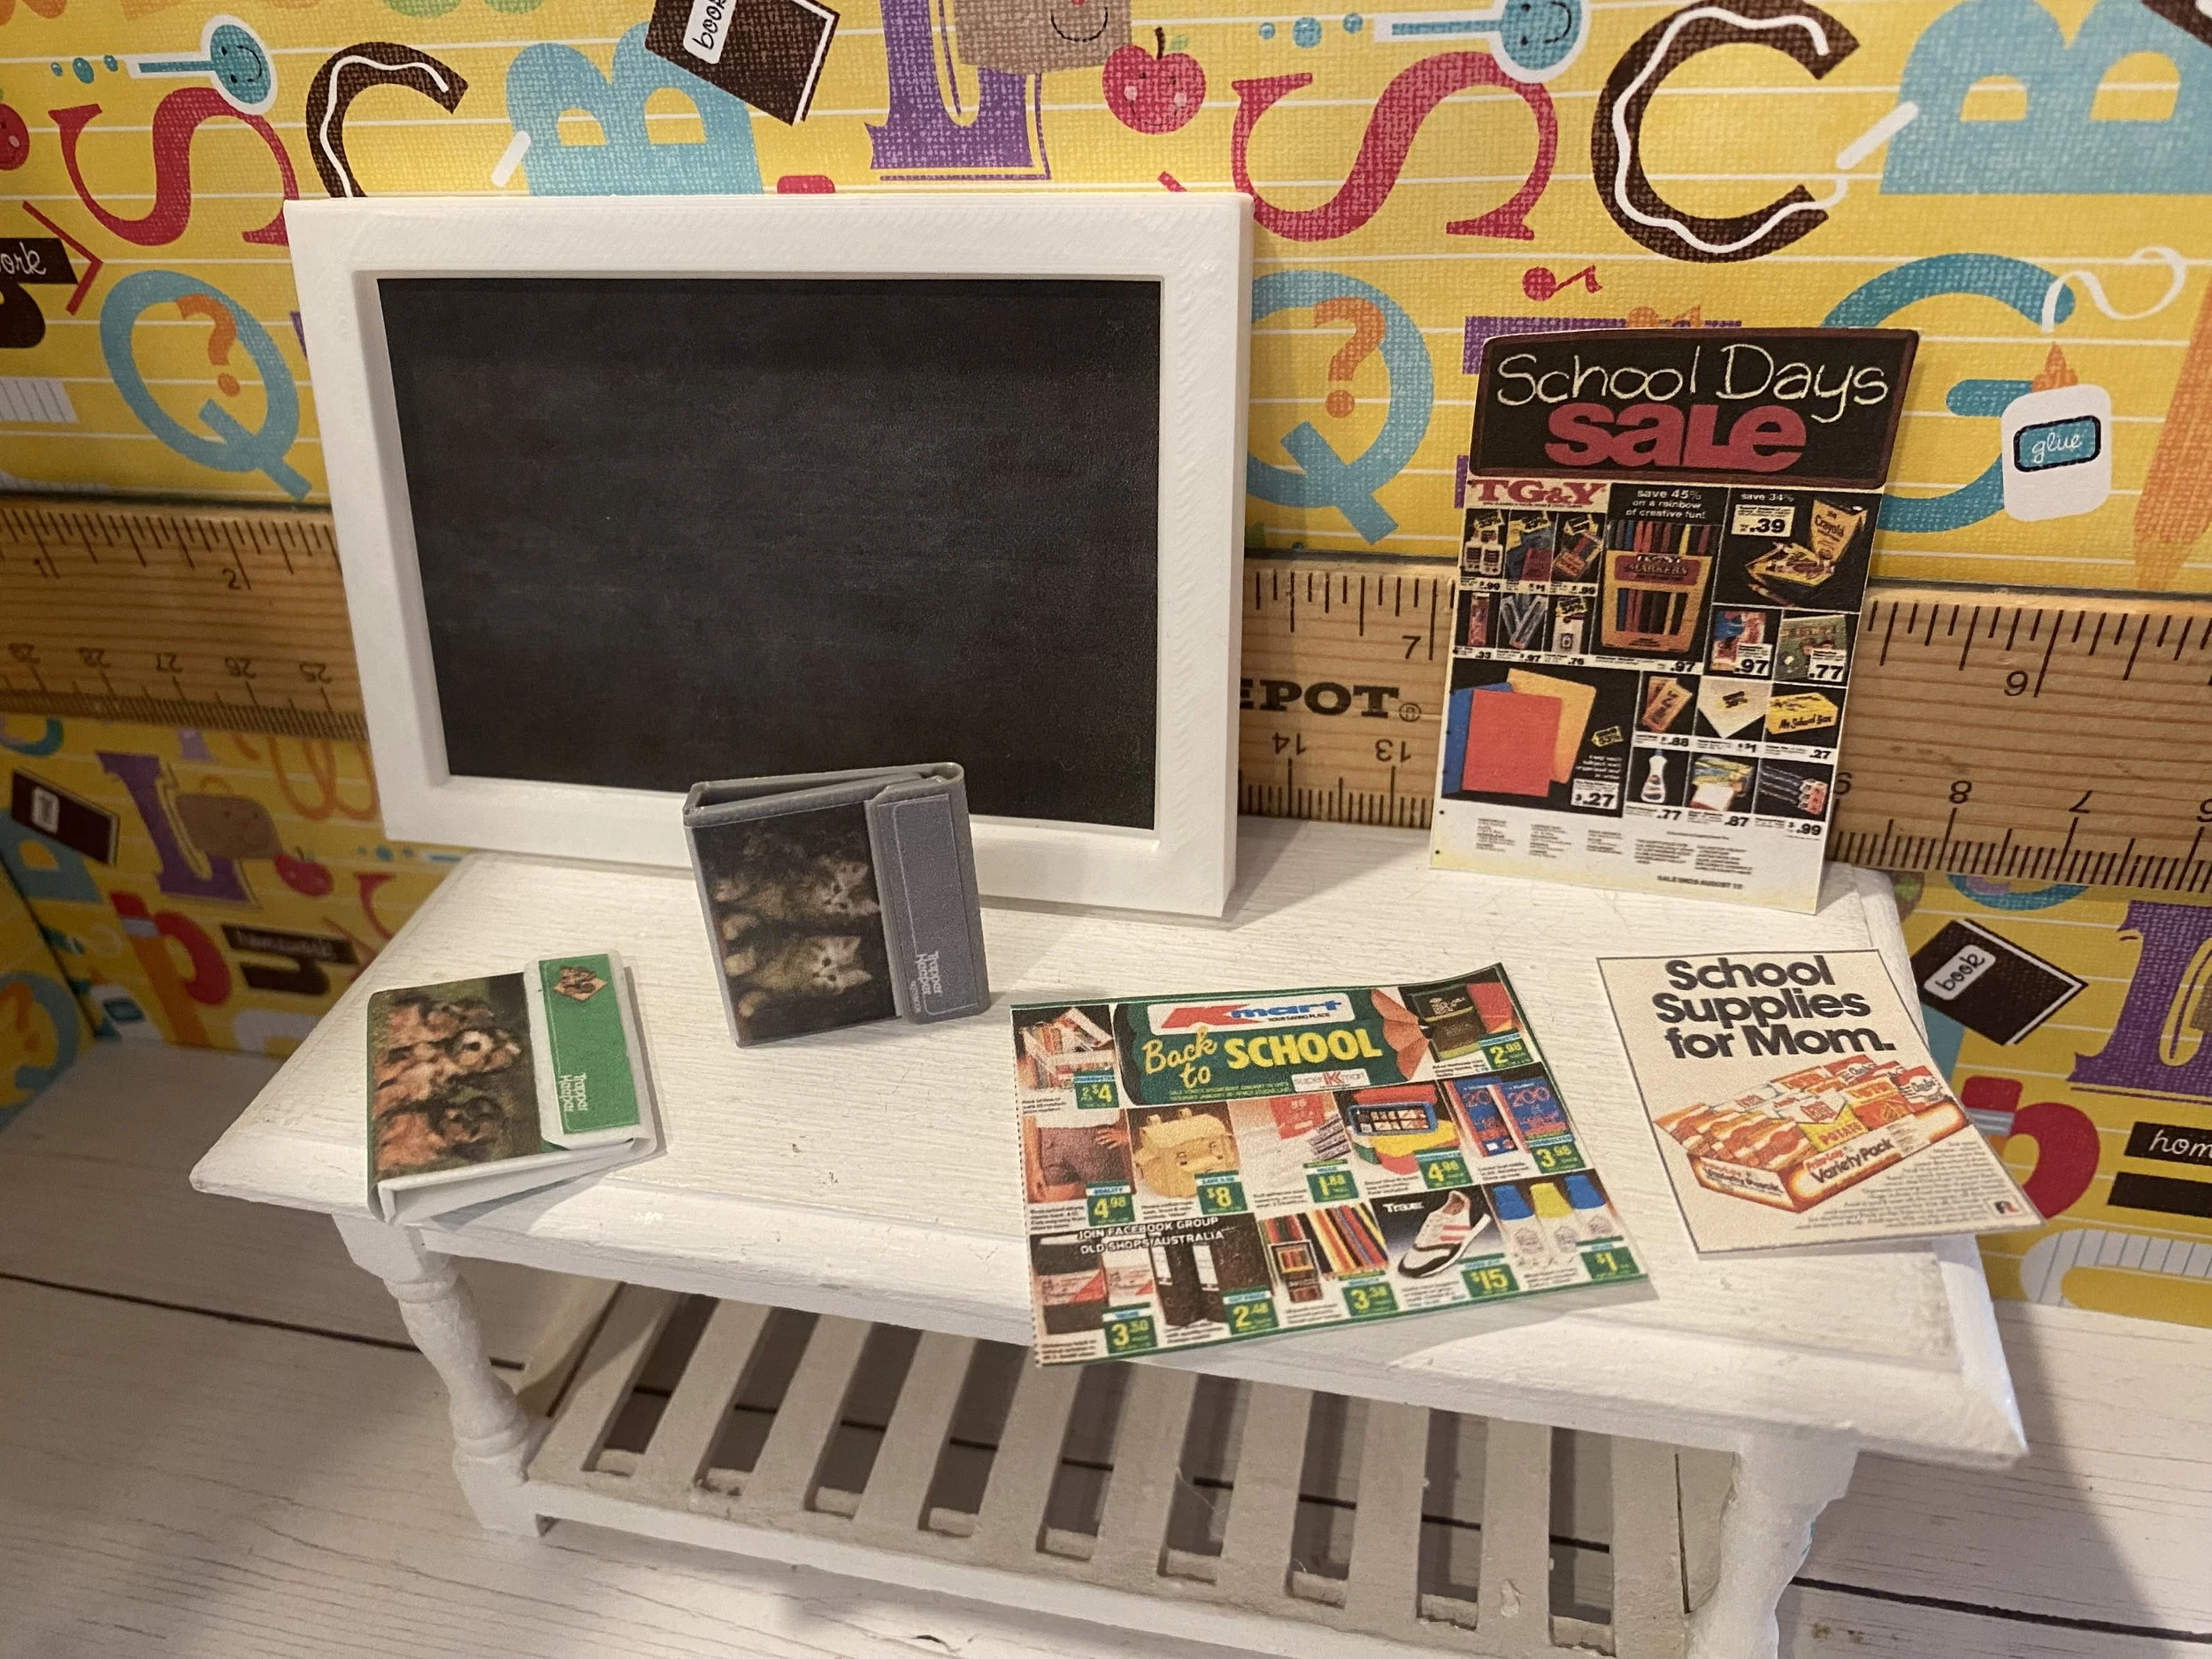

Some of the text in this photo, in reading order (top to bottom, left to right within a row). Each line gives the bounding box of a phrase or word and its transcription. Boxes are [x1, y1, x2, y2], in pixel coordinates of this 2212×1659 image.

[1230, 51, 1558, 243] S
[1592, 0, 1859, 265] C
[99, 269, 311, 501] Q
[1497, 343, 1889, 424] School Days
[2032, 431, 2082, 464] glue
[1469, 479, 1604, 505] TG&Y
[1637, 488, 1701, 500] save 45%
[1659, 500, 1701, 509] rainbow
[1639, 509, 1682, 518] creative
[1402, 635, 1421, 659] 7
[2003, 670, 2030, 697] 9
[1271, 732, 1307, 757] 14
[1374, 738, 1412, 763] 13
[1949, 780, 1973, 804] 8
[1664, 955, 1836, 991] School
[1935, 950, 1986, 992] book
[1651, 987, 1871, 1030] Supplies
[1141, 1024, 1218, 1074] Back
[1224, 1028, 1383, 1070] SCHOOL
[1665, 1023, 1897, 1059] for Mom.
[1179, 1062, 1211, 1089] to
[1810, 1138, 1895, 1183] Variety Pack
[1077, 1216, 1219, 1240] JOIN FACEBOOK GROUP
[1080, 1229, 1225, 1255] OLD SHOPS AUSTRALIA
